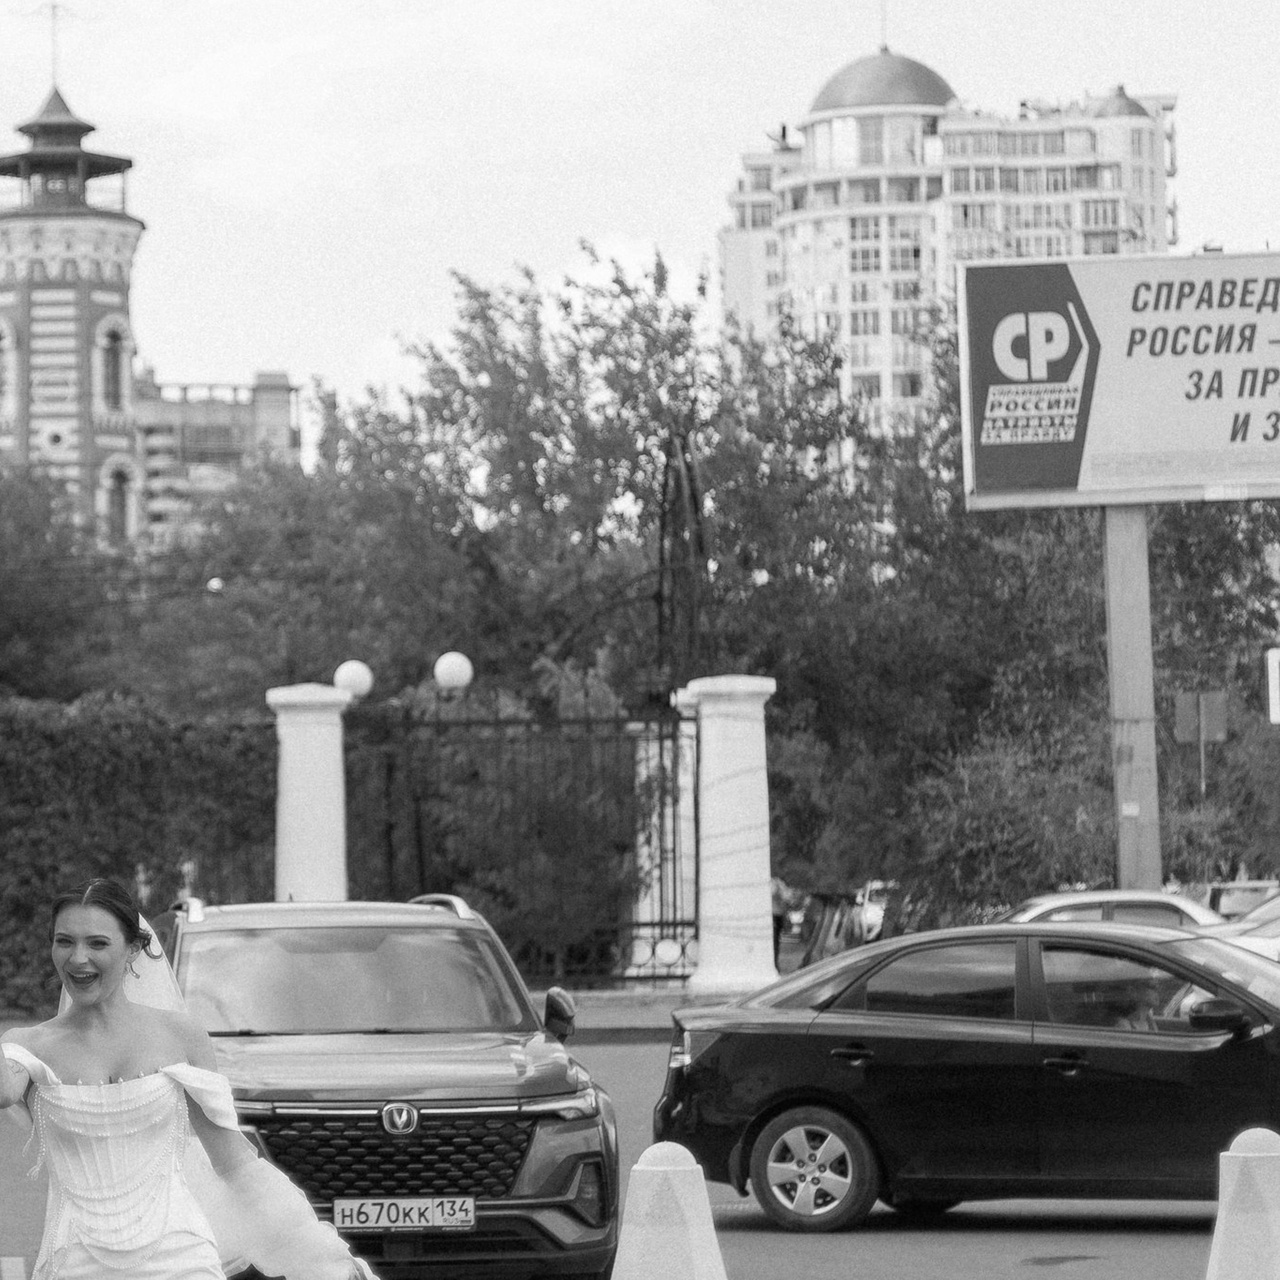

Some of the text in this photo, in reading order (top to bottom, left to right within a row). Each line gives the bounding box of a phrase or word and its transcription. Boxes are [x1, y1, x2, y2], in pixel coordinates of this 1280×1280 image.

[1131, 278, 1280, 313] СПРАВЕД
[992, 311, 1070, 382] СР
[1126, 323, 1257, 357] РОССИЯ
[1185, 367, 1280, 400] ЗА ПР
[989, 397, 1077, 413] РОССИЯ
[1230, 412, 1251, 442] И
[340, 1199, 471, 1225] Н670КК 134
